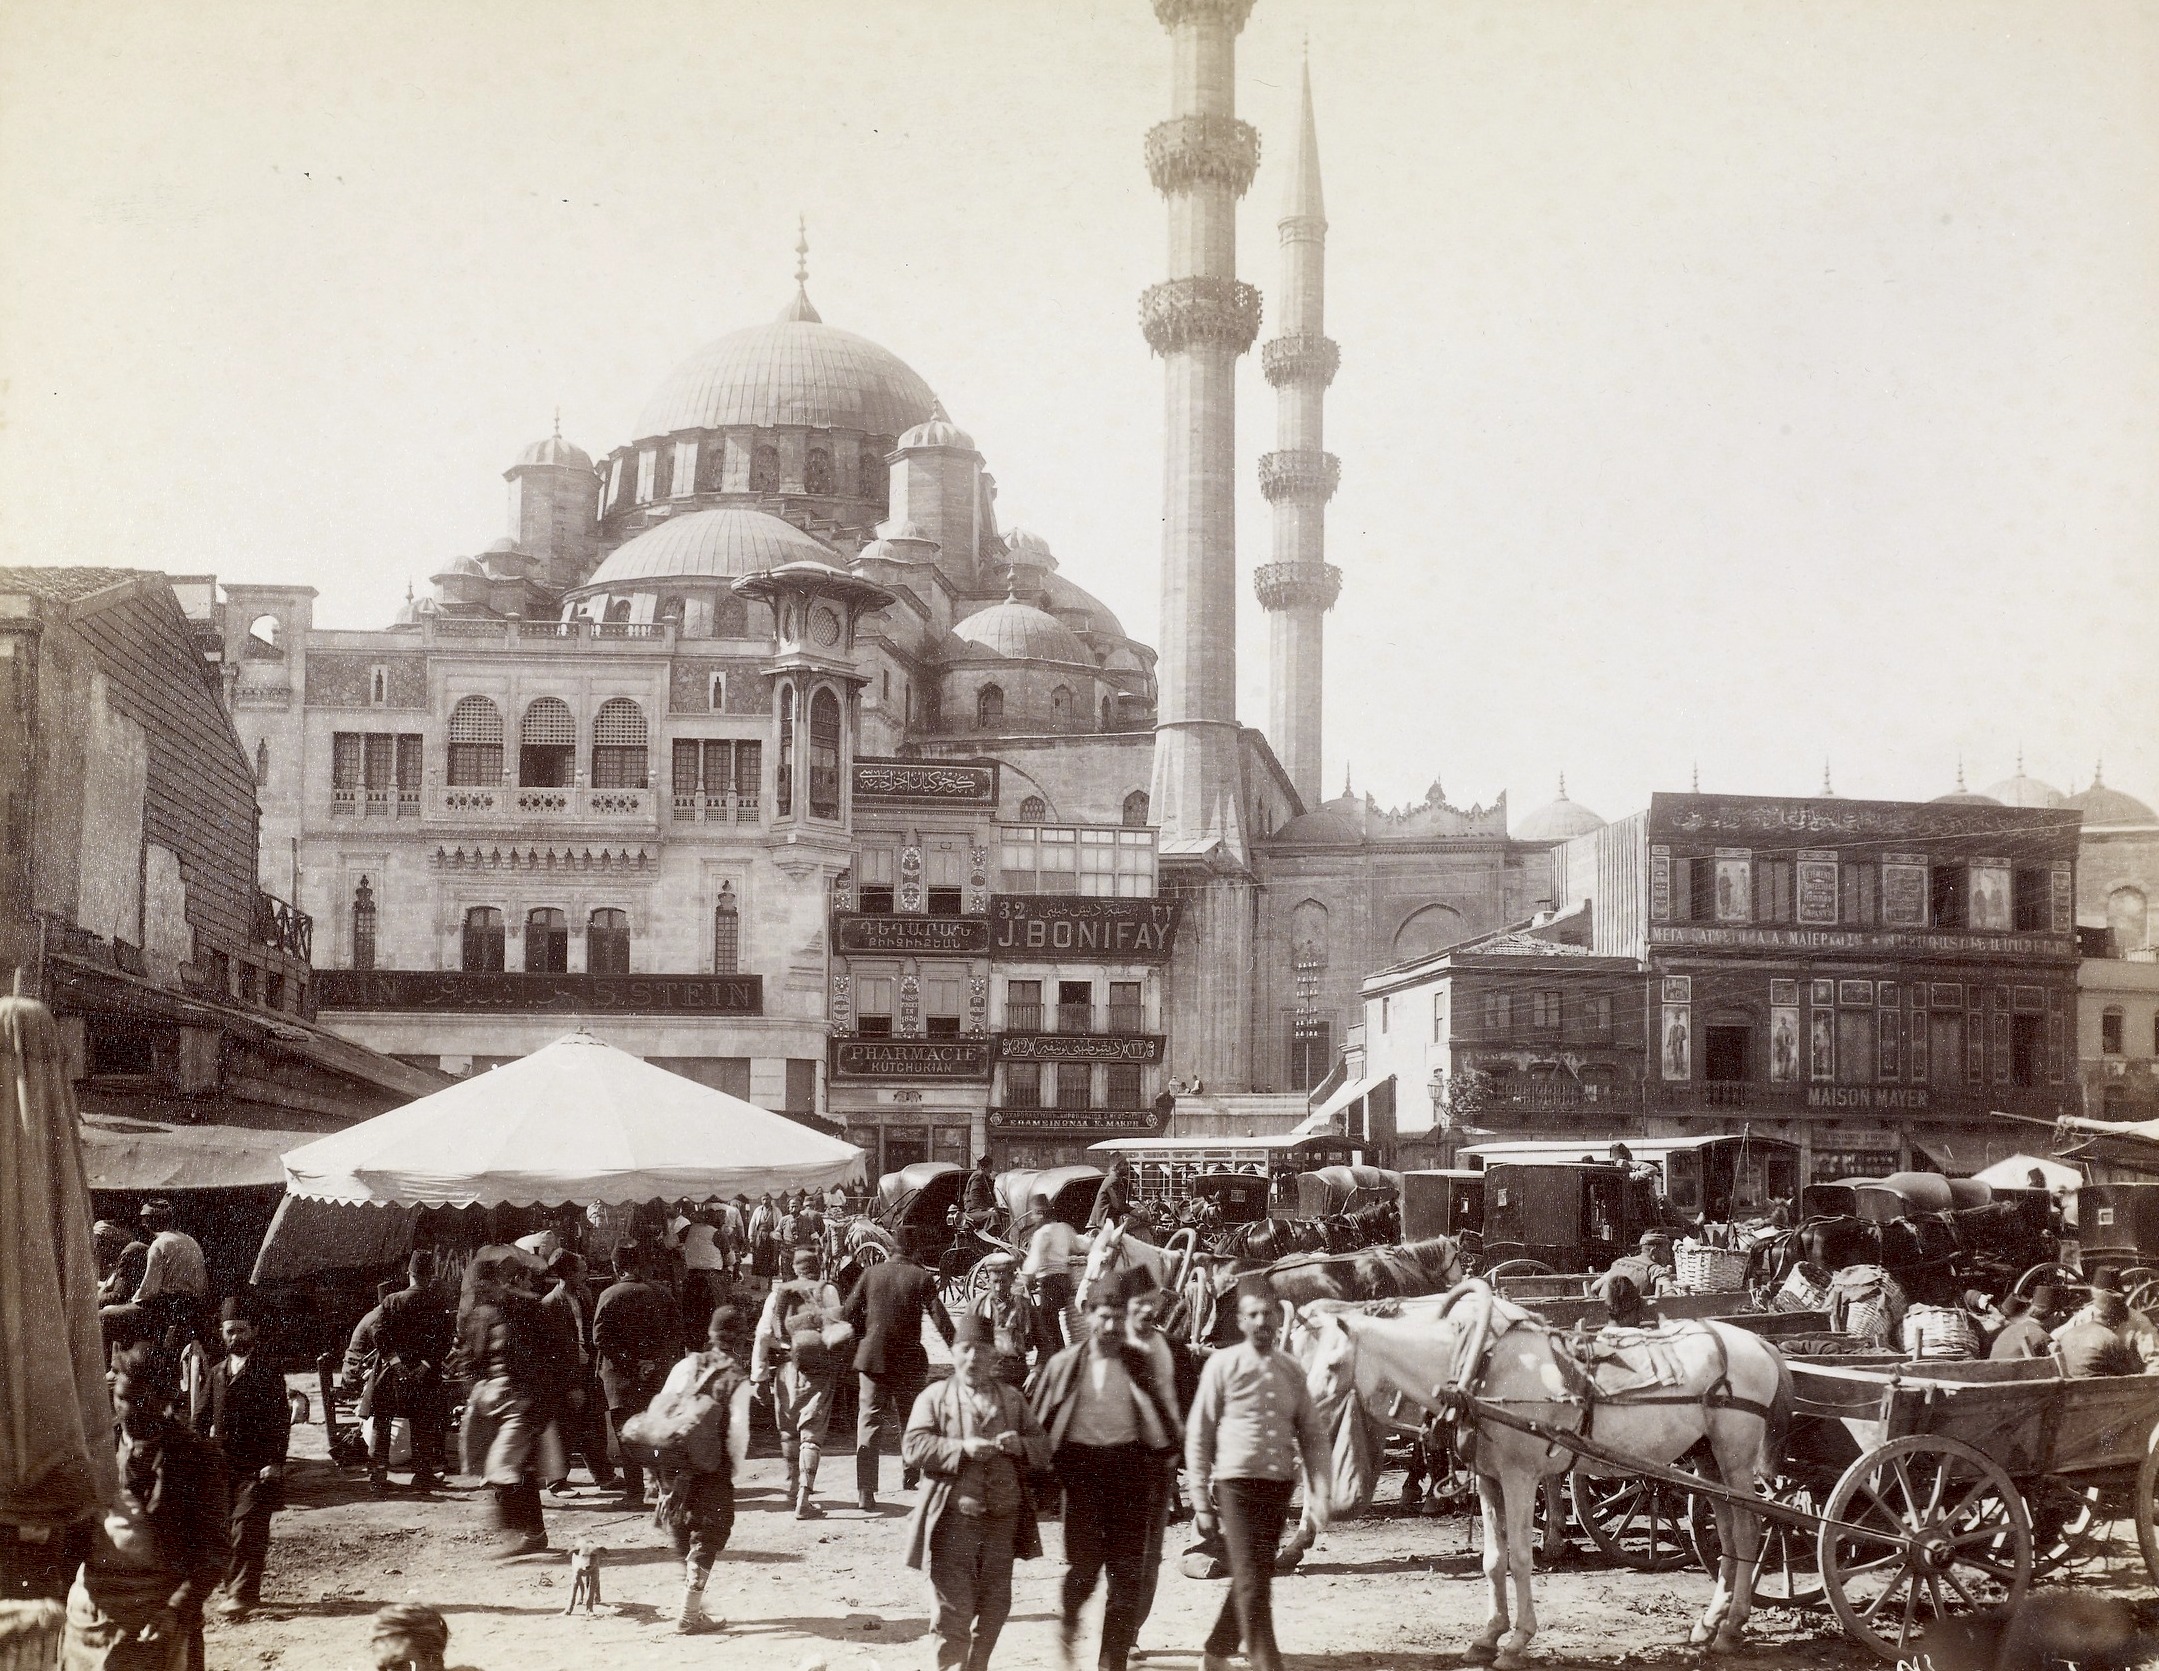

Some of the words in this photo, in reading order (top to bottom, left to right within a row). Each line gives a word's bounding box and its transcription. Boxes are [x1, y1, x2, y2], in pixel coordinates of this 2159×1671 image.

[998, 901, 1026, 920] 32
[630, 981, 752, 1008] STEIN
[851, 1046, 977, 1061] PHARMACIE
[871, 1062, 952, 1073] KUTCHUKIAN
[1807, 1087, 1870, 1107] MAISON
[1875, 1088, 1928, 1108] MAYER
